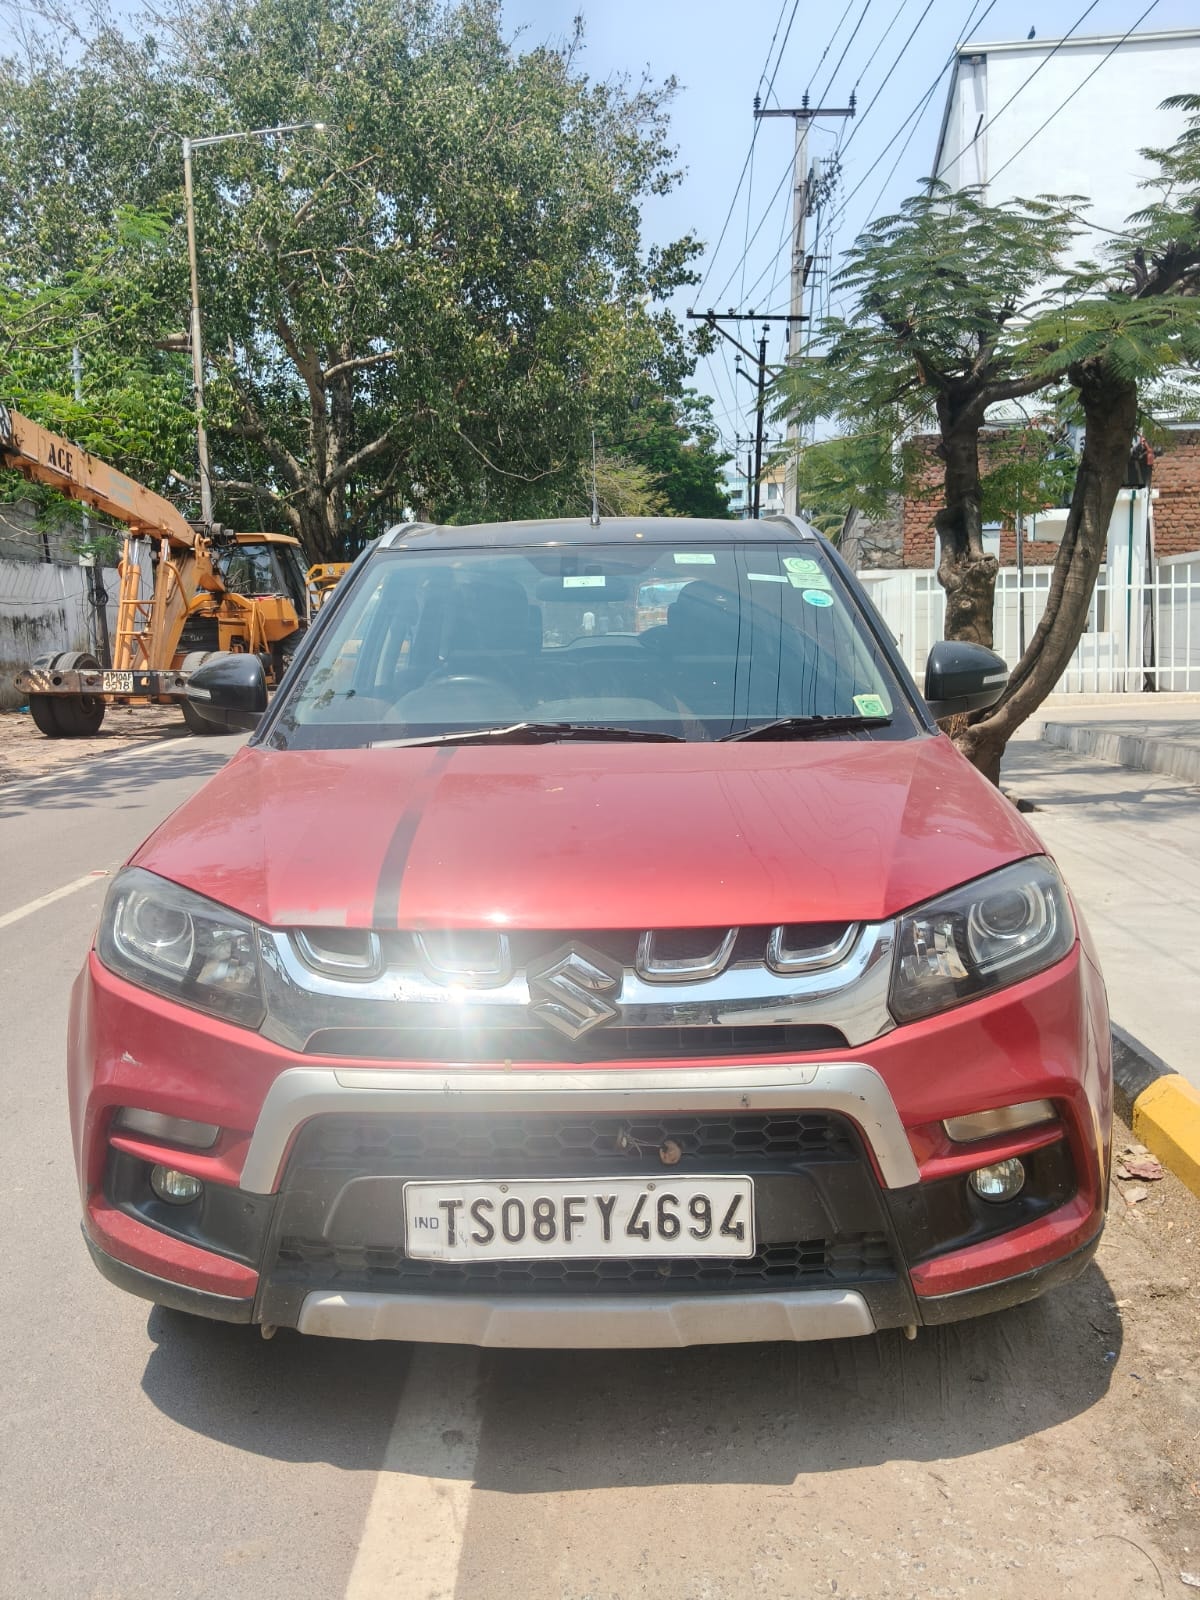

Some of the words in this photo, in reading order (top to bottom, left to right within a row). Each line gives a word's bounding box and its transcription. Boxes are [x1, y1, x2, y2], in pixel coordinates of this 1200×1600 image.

[47, 443, 73, 474] ACE
[414, 1216, 439, 1230] IND
[438, 1193, 745, 1247] TS08FY4694
